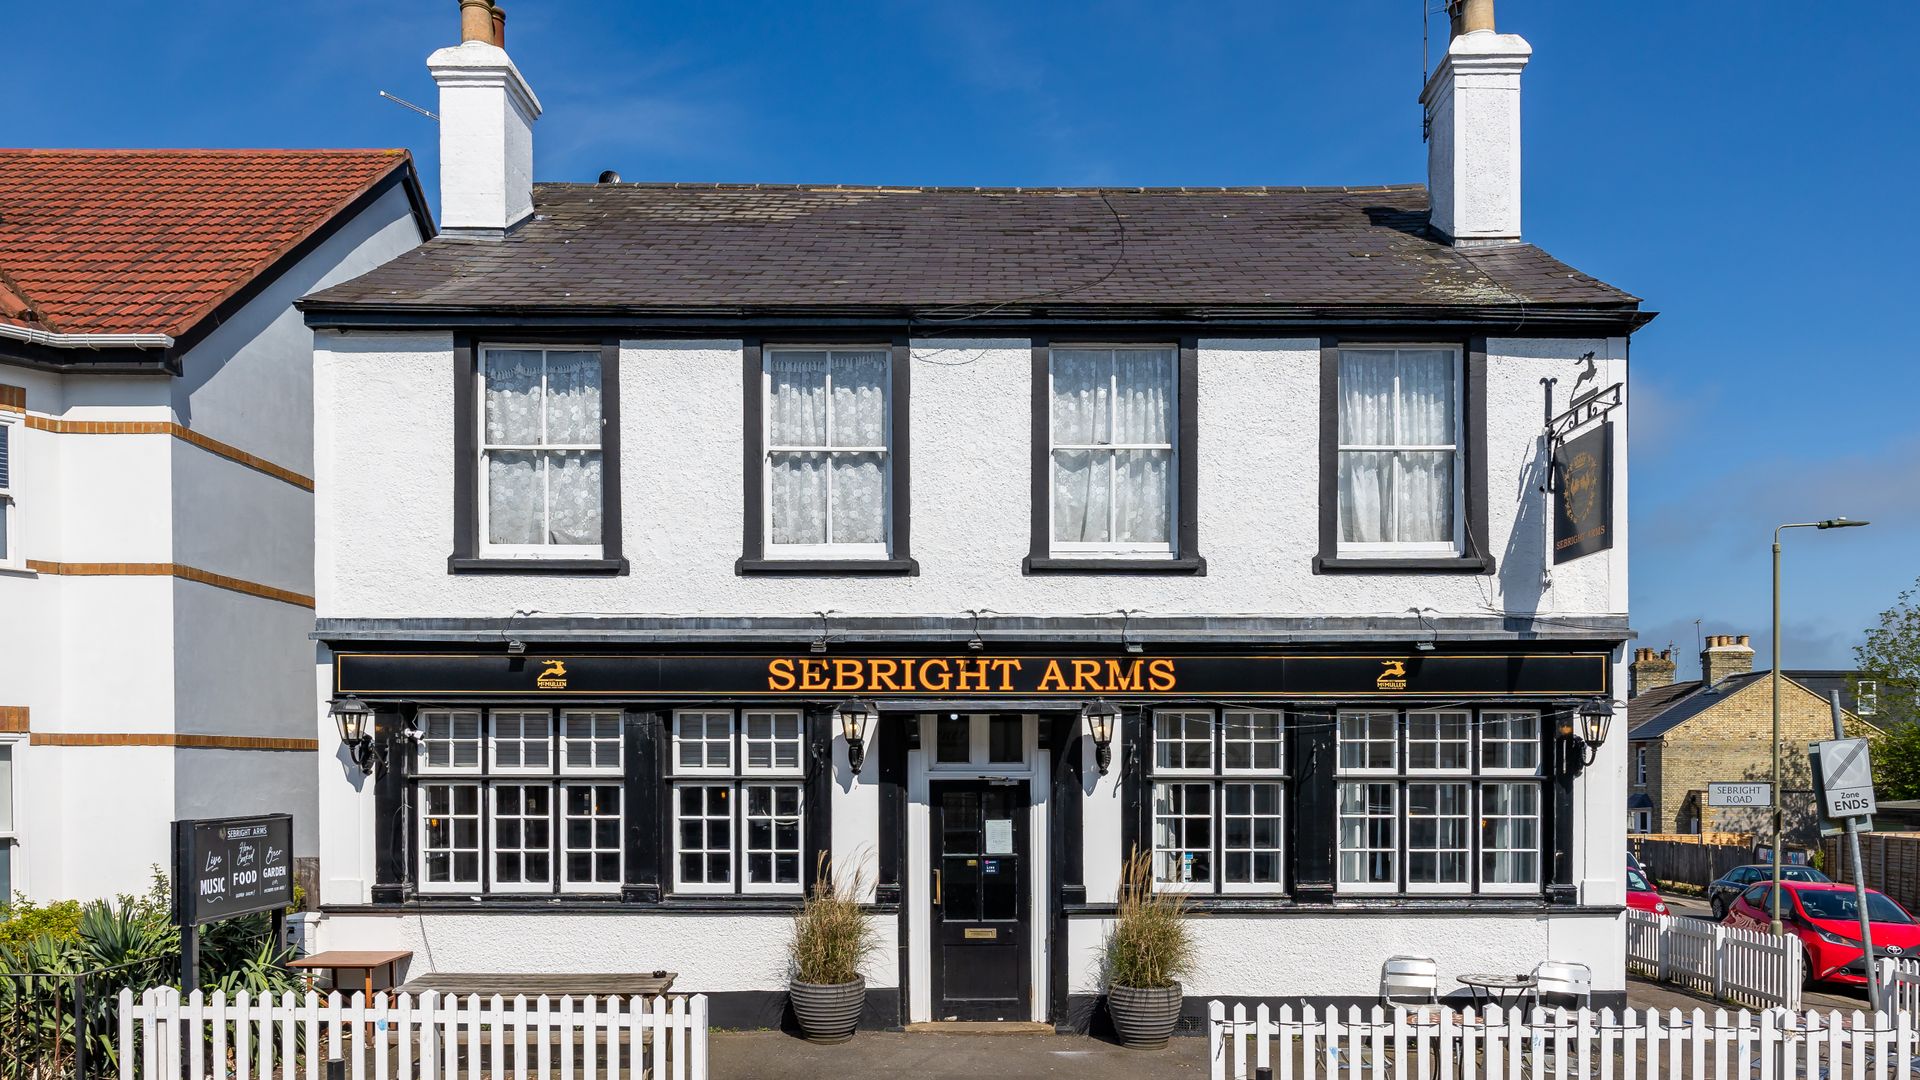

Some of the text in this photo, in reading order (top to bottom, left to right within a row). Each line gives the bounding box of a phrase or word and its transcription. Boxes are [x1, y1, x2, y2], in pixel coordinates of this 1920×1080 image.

[768, 659, 1177, 691] SEBRIGHT ARMS
[1717, 786, 1762, 795] SEBRIGHT
[1841, 791, 1860, 799] Zone
[1726, 795, 1753, 803] ROAD
[1834, 799, 1869, 811] ENDS
[227, 827, 267, 838] SEBRIGHT ARMS
[205, 851, 222, 872] Live
[265, 846, 283, 865] Beer
[233, 870, 257, 886] FOOD
[263, 866, 286, 878] GARDEN
[200, 877, 225, 895] MUSIC
